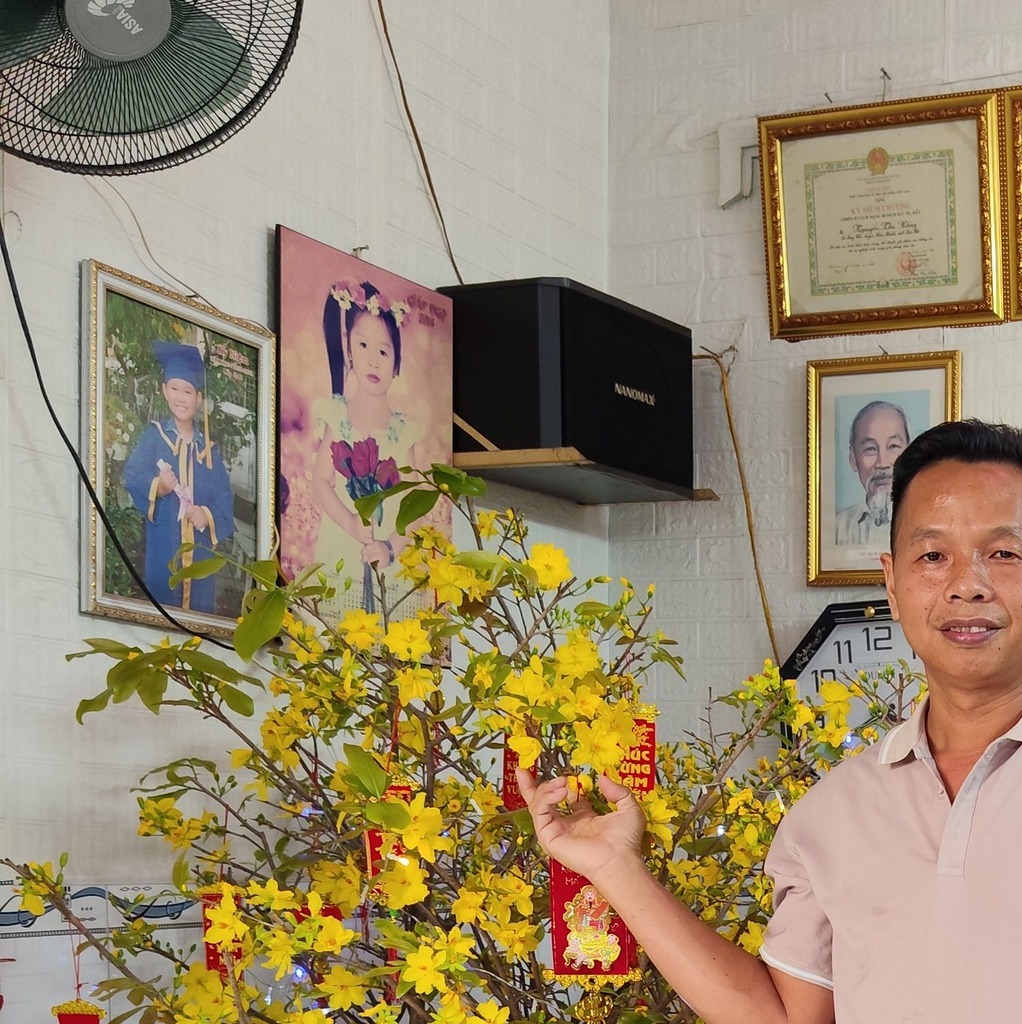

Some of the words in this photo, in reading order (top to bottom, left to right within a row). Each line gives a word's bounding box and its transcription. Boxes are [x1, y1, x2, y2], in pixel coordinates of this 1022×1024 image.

[116, 8, 144, 35] ASIA
[862, 626, 893, 652] 12
[833, 640, 853, 665] 11
[619, 761, 651, 774] ỪNG
[620, 749, 651, 761] HÚC
